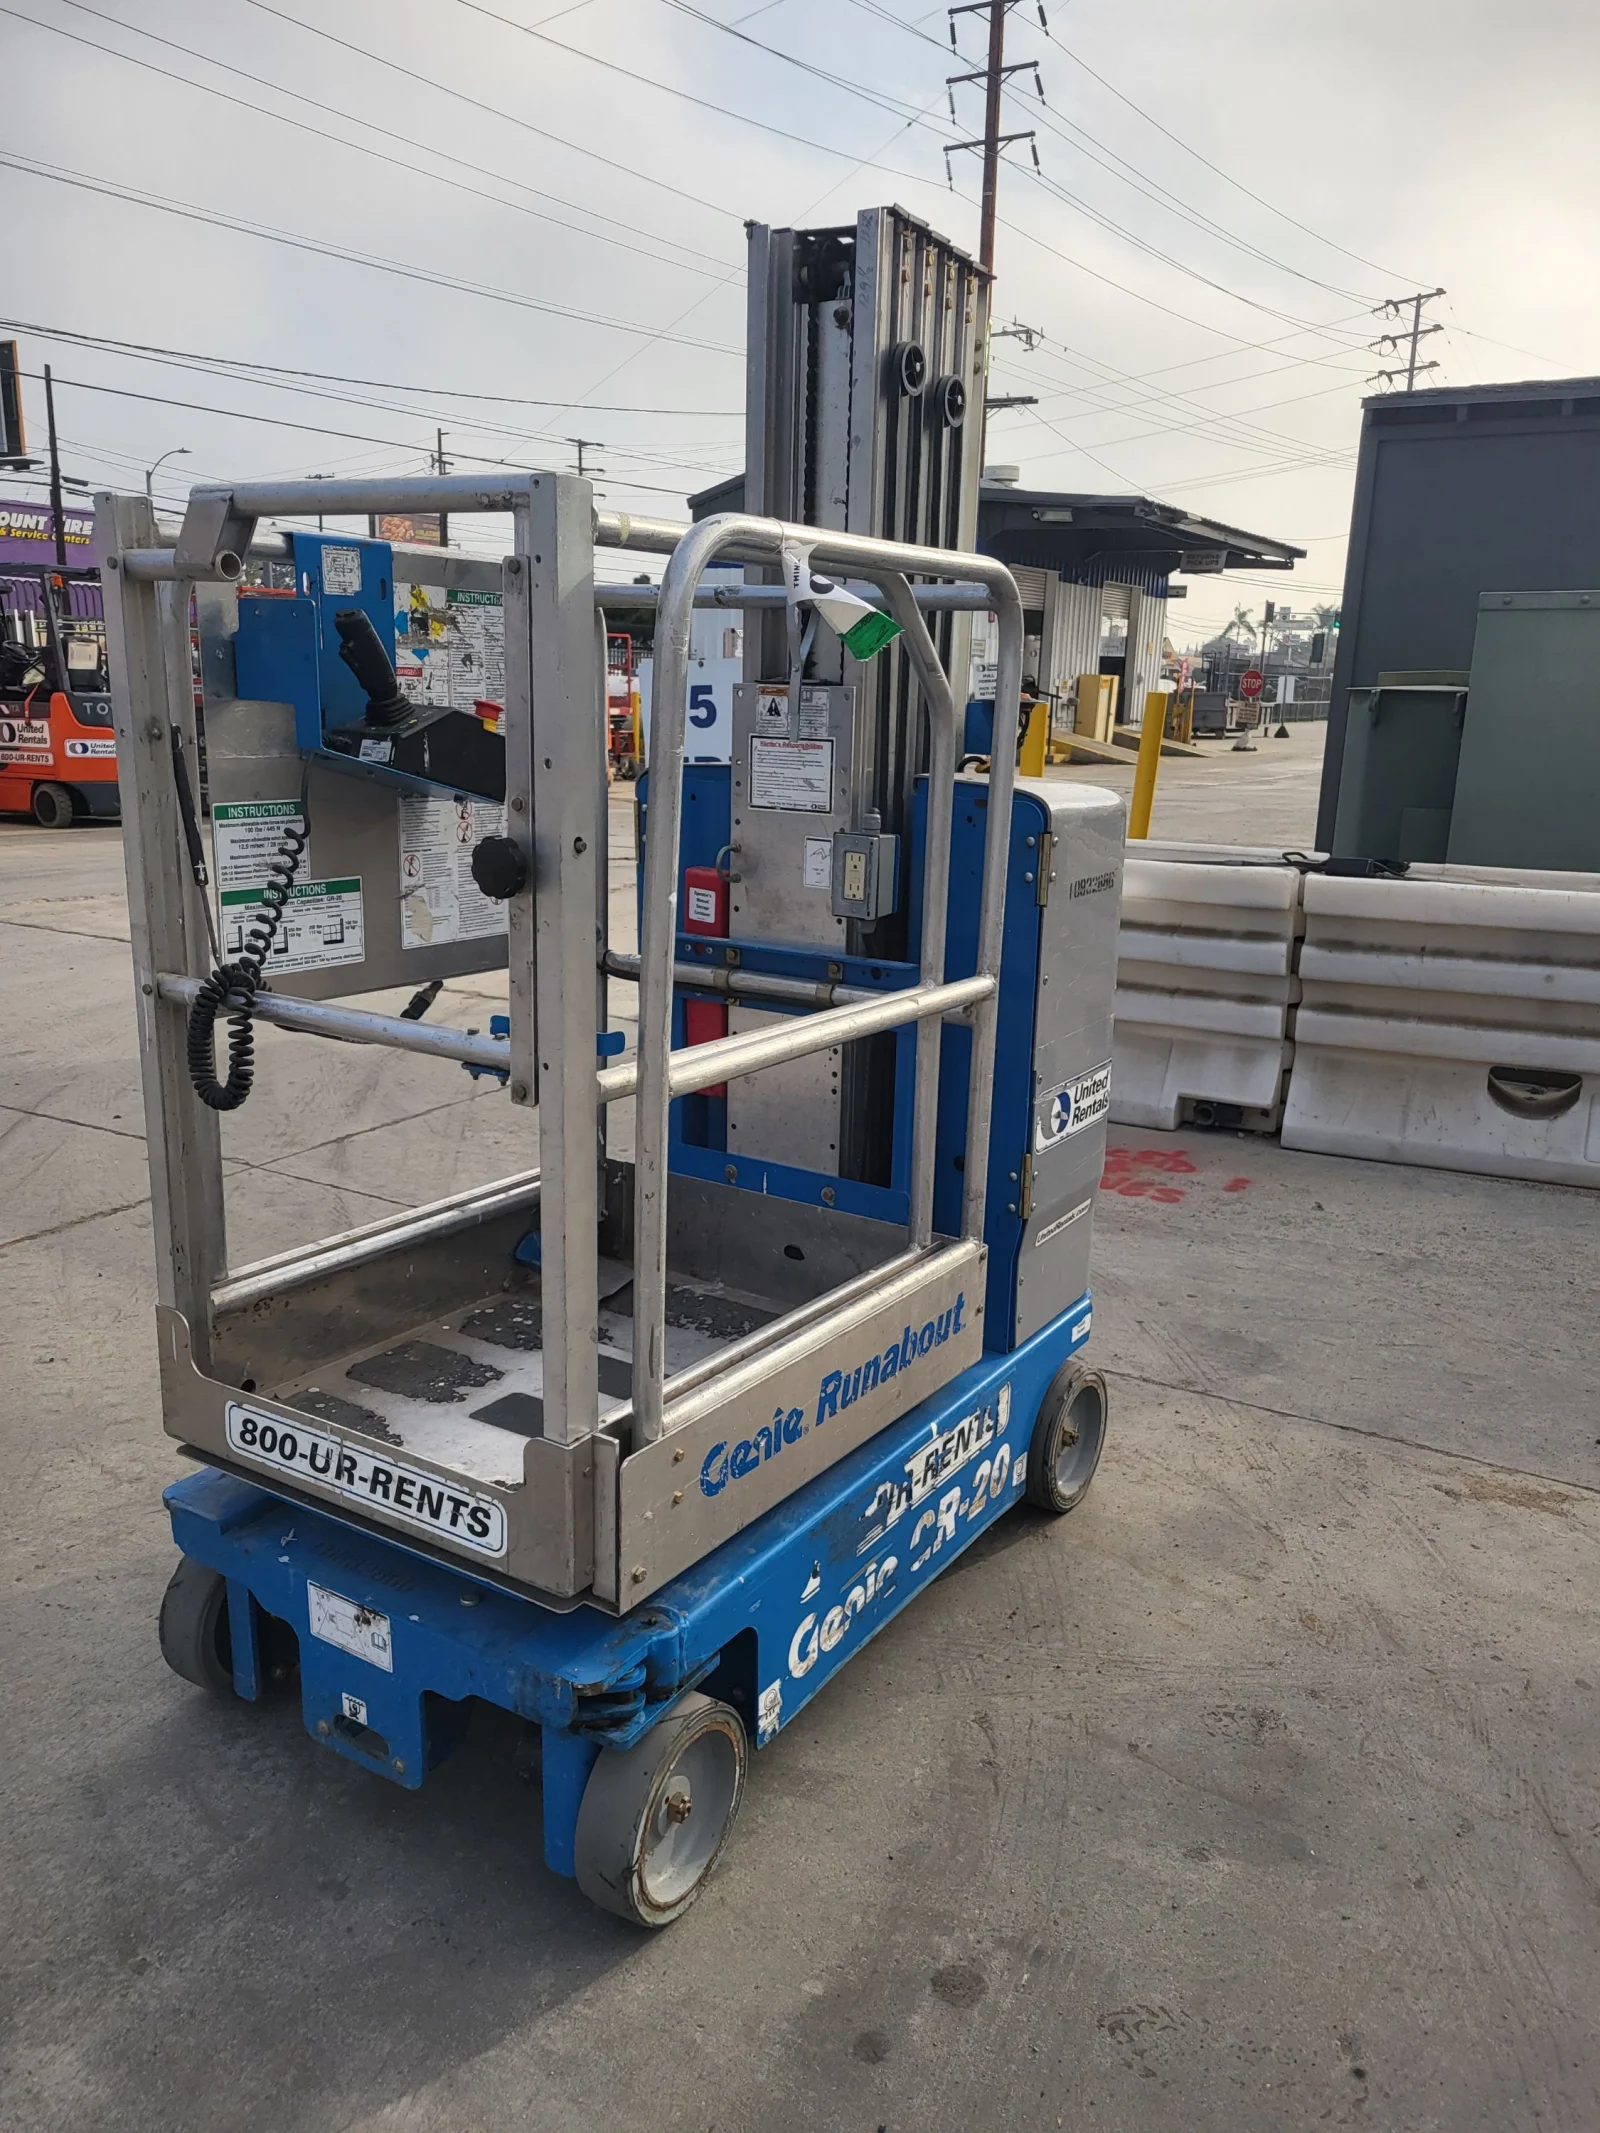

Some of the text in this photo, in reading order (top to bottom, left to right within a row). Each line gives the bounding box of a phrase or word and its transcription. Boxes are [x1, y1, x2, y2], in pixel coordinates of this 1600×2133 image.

[10, 528, 49, 540] Service
[52, 534, 90, 545] Cnters
[1242, 678, 1262, 689] STOP
[689, 685, 717, 728] 5
[17, 723, 44, 734] United
[18, 734, 48, 744] Rentals
[1, 753, 50, 763] 800-UR-RENTS
[228, 804, 296, 818] INSTRUCTIONS
[263, 883, 327, 899] INSUCTIONS
[1073, 1070, 1110, 1105] United
[1071, 1092, 1109, 1127] Rentals
[700, 1291, 966, 1497] Genie Runabout
[239, 1418, 492, 1538] 800-UR-RENTS
